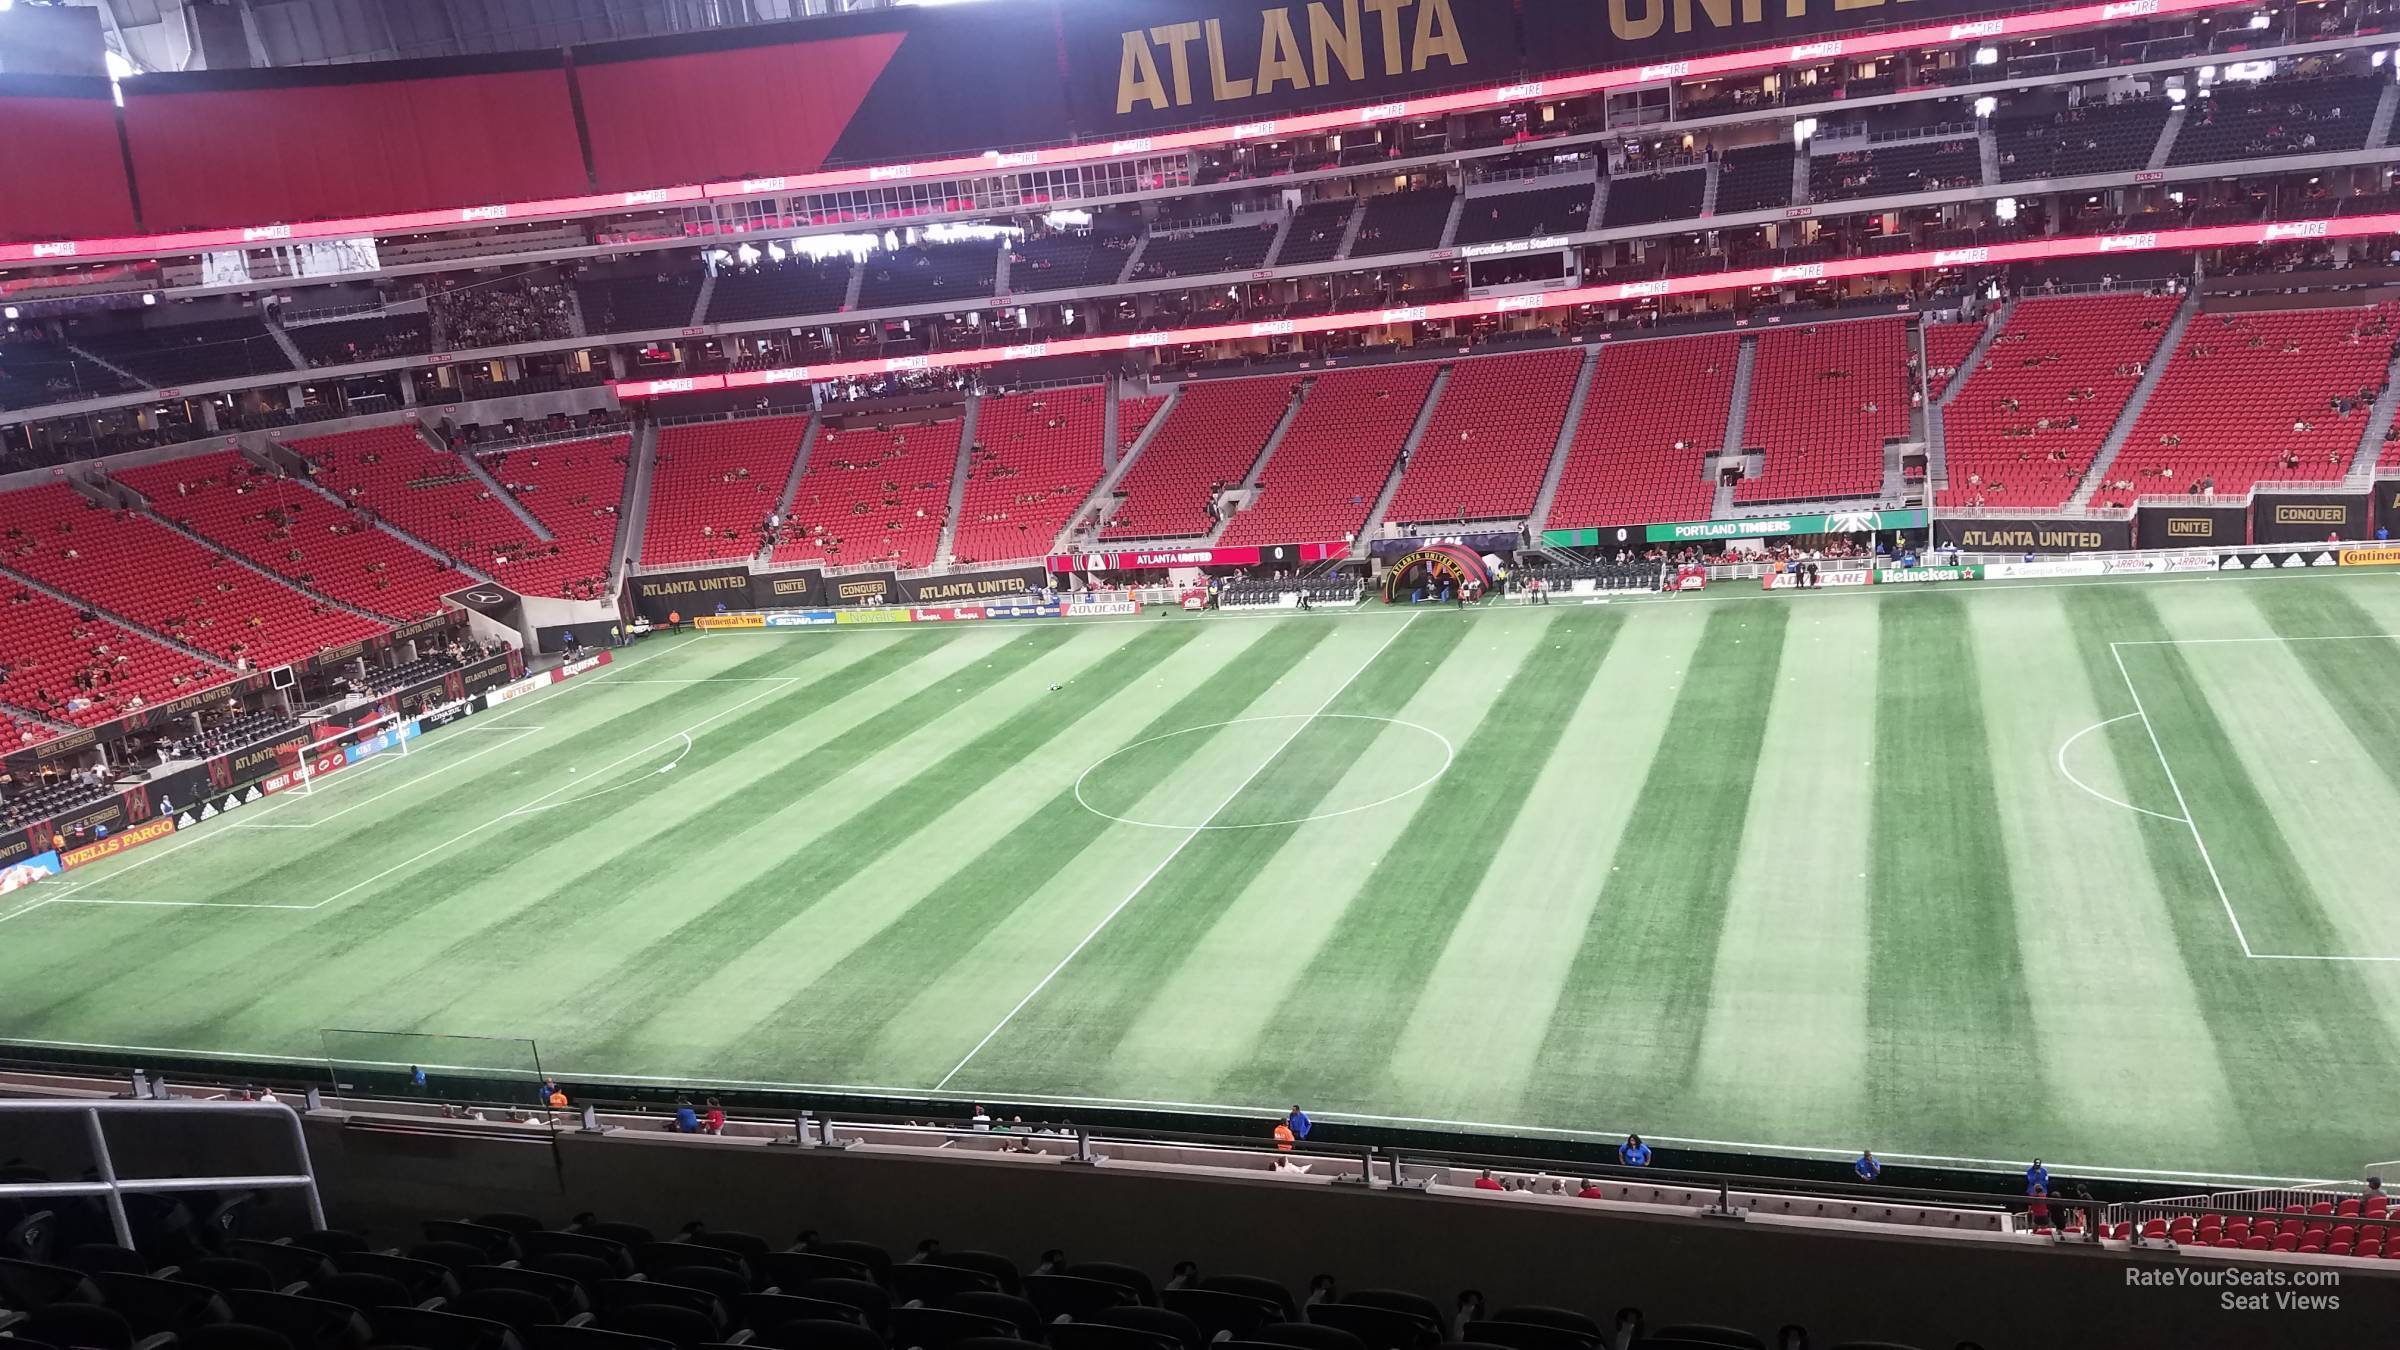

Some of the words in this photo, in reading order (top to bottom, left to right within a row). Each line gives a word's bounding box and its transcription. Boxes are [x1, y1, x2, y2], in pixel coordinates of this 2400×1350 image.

[1117, 0, 1469, 114] ATLANTA
[1461, 242, 1528, 258] Mercedes-Benz
[1530, 236, 1569, 249] Stadium
[2280, 509, 2342, 521] CONQUER
[1617, 528, 1627, 542] 0
[1675, 524, 1736, 536] PORTLAND
[1738, 521, 1791, 533] TIMBERS
[2172, 522, 2209, 533] UNITE
[1962, 531, 2035, 546] ATLANTA
[2039, 532, 2102, 548] UNITED
[1137, 554, 1178, 565] ATLANTA
[1177, 552, 1213, 563] UNITED
[1274, 546, 1284, 559] 0
[1392, 554, 1422, 576] ATLANTA
[1424, 553, 1454, 566] UNITED
[1453, 564, 1463, 577] FC
[2115, 559, 2145, 568] ARROW
[2178, 557, 2209, 567] ARROW
[1882, 568, 1959, 583] Heineken
[2018, 566, 2053, 577] Georgia
[2055, 566, 2083, 575] Power
[643, 581, 697, 597] ATLANTA
[699, 576, 747, 591] UNITED
[776, 581, 804, 592] UNITE
[842, 583, 884, 595] CONQUER
[919, 583, 976, 600] ATLANTA
[978, 578, 1025, 594] UNITED
[851, 610, 896, 622] Novelis
[1067, 603, 1133, 615] ADVOCARE
[395, 625, 423, 640] ATLANTA
[422, 617, 446, 633] UNITED
[696, 615, 739, 627] Continental
[746, 617, 763, 625] TIRE
[562, 655, 600, 677] EQUIFAX
[465, 670, 488, 685] ATLANTA
[487, 663, 508, 676] UNITED
[502, 681, 536, 699] LOTTERY
[166, 696, 202, 714] ATLANTA
[202, 686, 232, 703] UNITED
[431, 706, 462, 722] LUNAZUL
[235, 747, 276, 770] ATLANTA
[275, 734, 310, 754] UNITED
[0, 841, 28, 859] NITED
[65, 838, 120, 866] WELLS
[121, 820, 174, 847] FARGO
